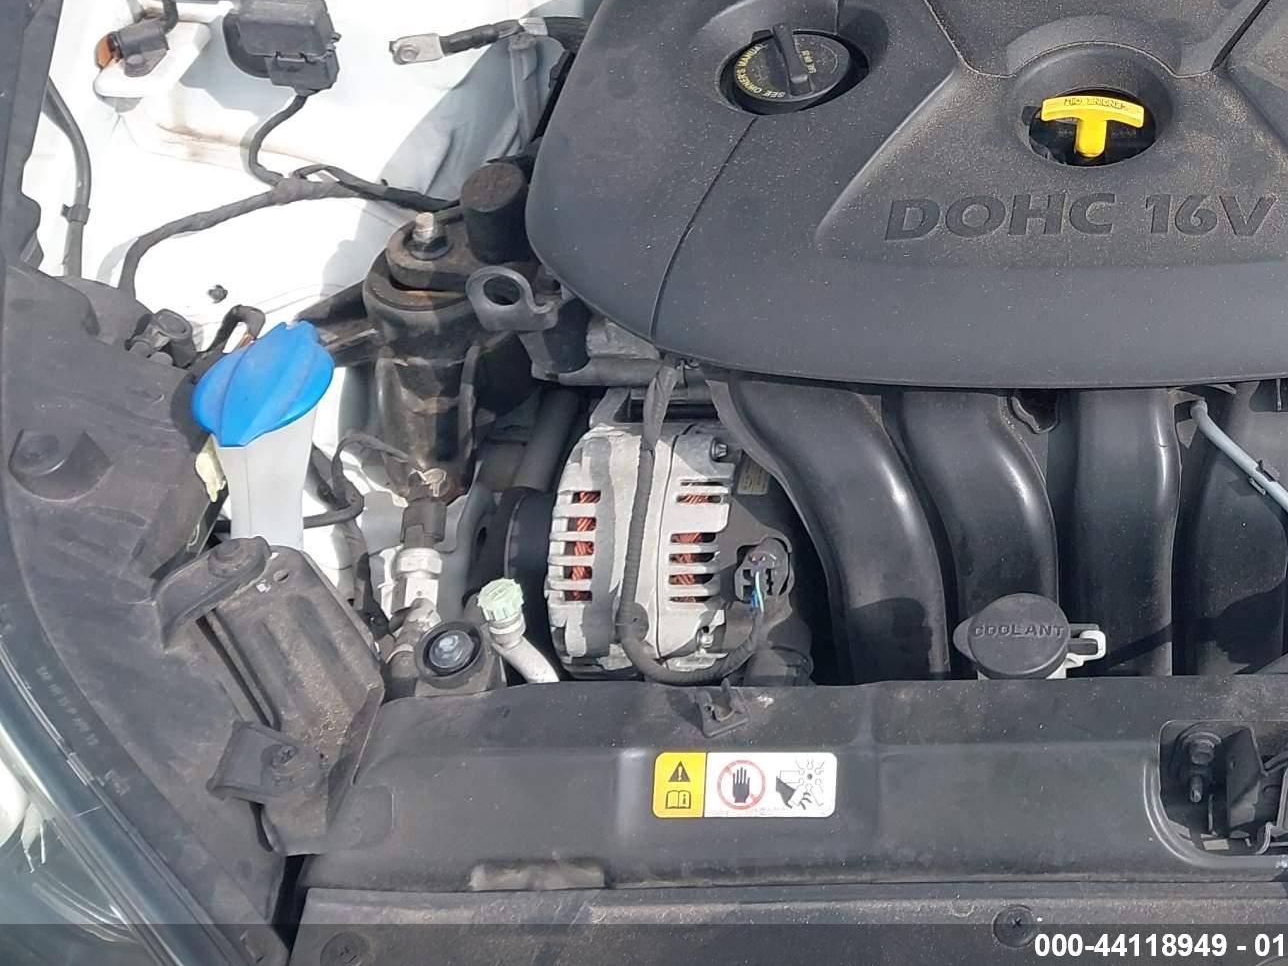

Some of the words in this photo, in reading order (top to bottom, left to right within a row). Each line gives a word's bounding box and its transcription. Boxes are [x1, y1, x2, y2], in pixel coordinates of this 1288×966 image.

[737, 42, 769, 68] MANUAL
[763, 90, 786, 99] SEE
[884, 193, 1116, 240] DOHC
[1145, 193, 1276, 237] 16V
[973, 623, 1065, 638] COOLANT
